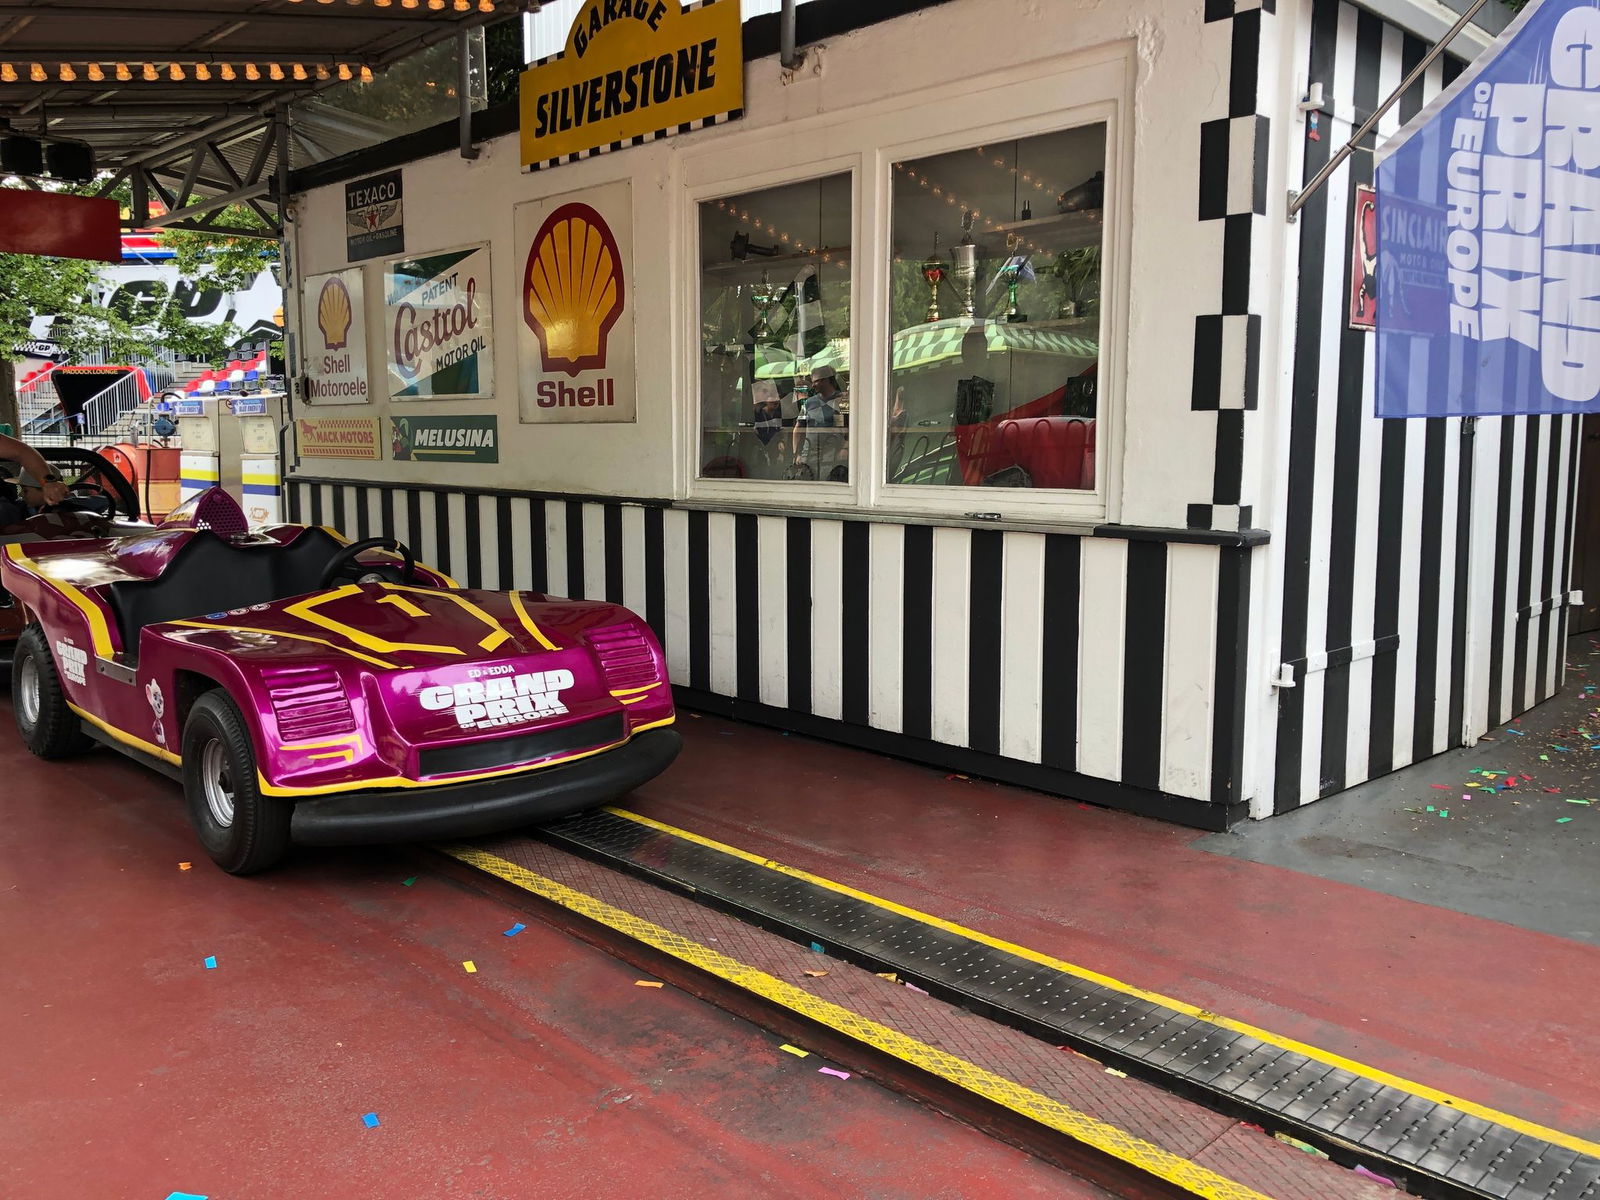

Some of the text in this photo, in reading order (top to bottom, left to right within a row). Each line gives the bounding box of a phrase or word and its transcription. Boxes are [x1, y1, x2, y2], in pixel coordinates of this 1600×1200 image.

[535, 37, 717, 138] SILVERSTONE
[348, 182, 396, 208] TEXACO
[1447, 81, 1492, 343] OF EUROPE
[1541, 6, 1600, 402] GRAND
[1481, 82, 1547, 352] PRIX
[421, 271, 458, 307] PATENT
[394, 277, 478, 379] Castrol
[324, 354, 350, 375] Shell
[436, 335, 486, 371] MOTOR OIL
[310, 376, 367, 398] Motoroele
[536, 378, 614, 408] Shell
[317, 430, 374, 444] MACK MOTORS
[415, 428, 494, 448] MELUSINA
[468, 669, 481, 678] ED
[489, 664, 515, 675] EDDA
[420, 669, 575, 710] GRAND
[454, 690, 565, 724] PRIX
[476, 706, 569, 728] EUROPE
